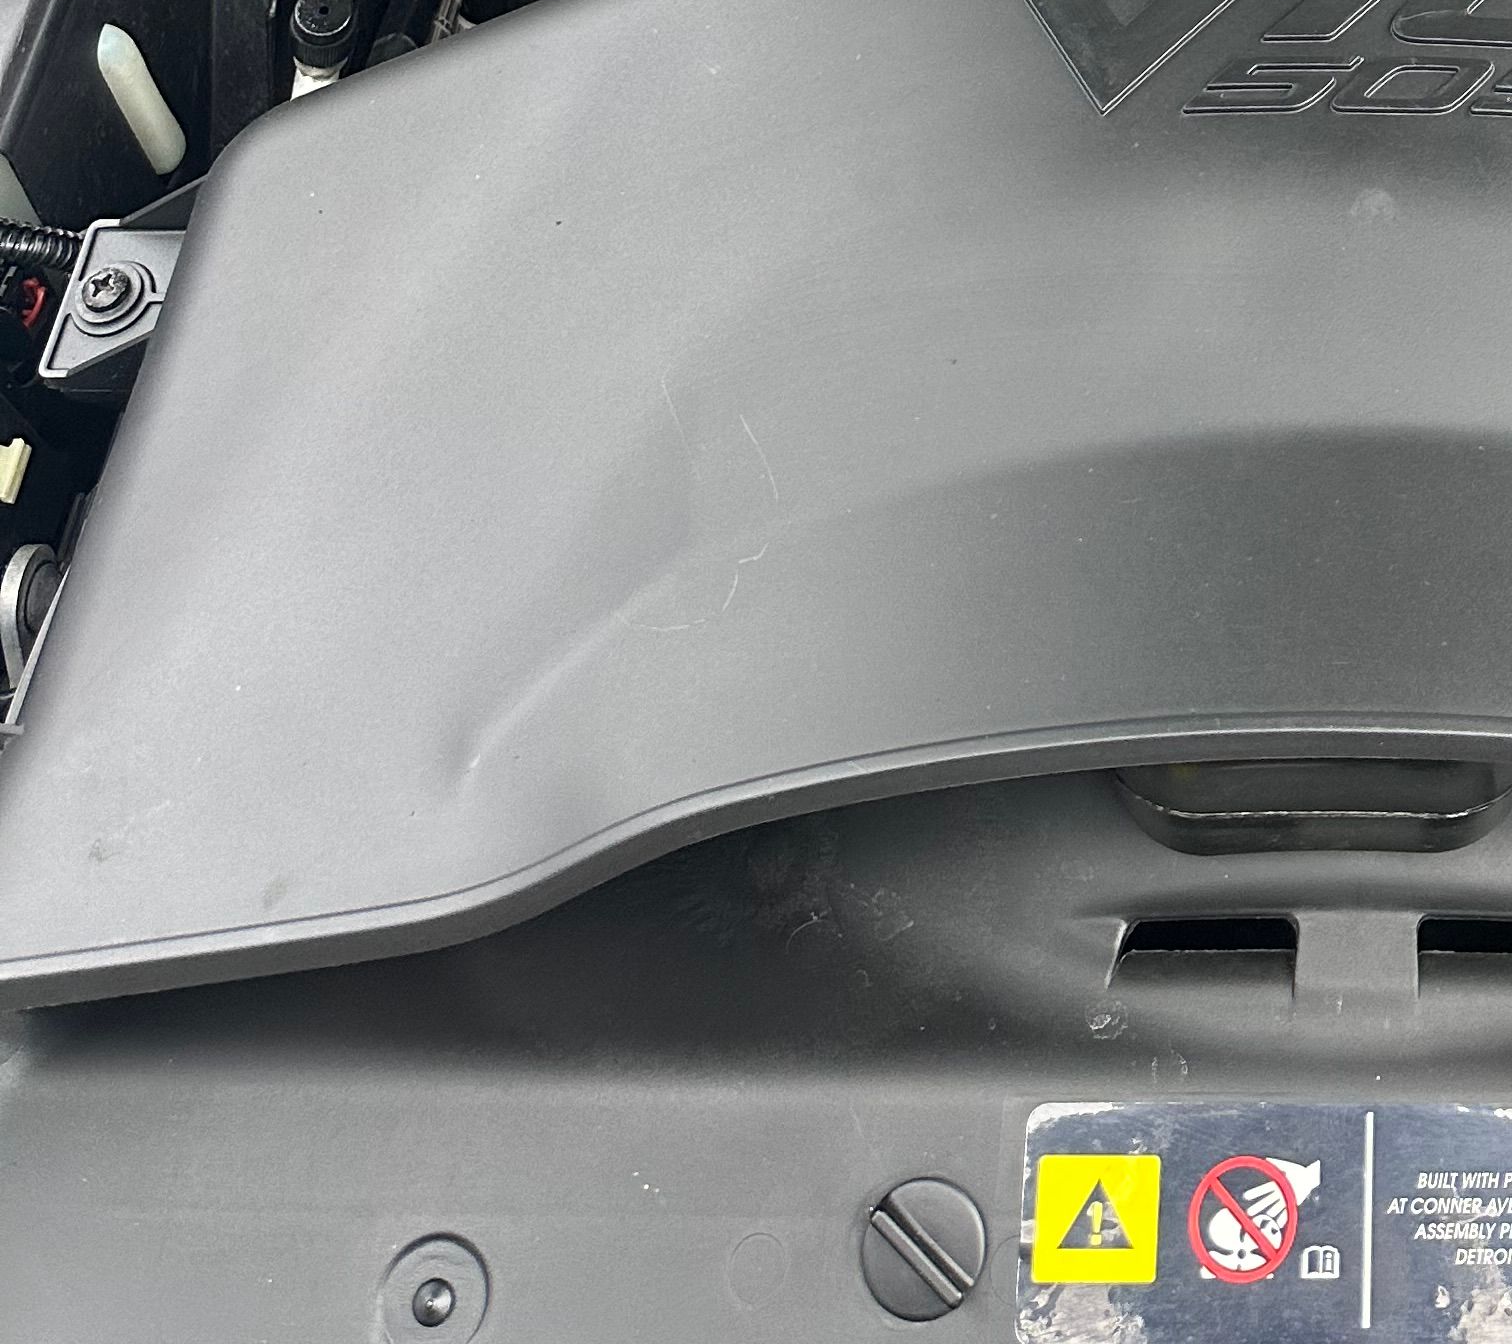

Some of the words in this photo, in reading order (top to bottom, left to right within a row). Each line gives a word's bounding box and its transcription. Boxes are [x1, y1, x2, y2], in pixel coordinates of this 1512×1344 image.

[1417, 1171, 1458, 1189] BUILT
[1461, 1171, 1499, 1189] WITH
[1387, 1197, 1408, 1215] AT
[1410, 1197, 1483, 1215] CONNER
[1414, 1222, 1497, 1240] ASSEMBLY
